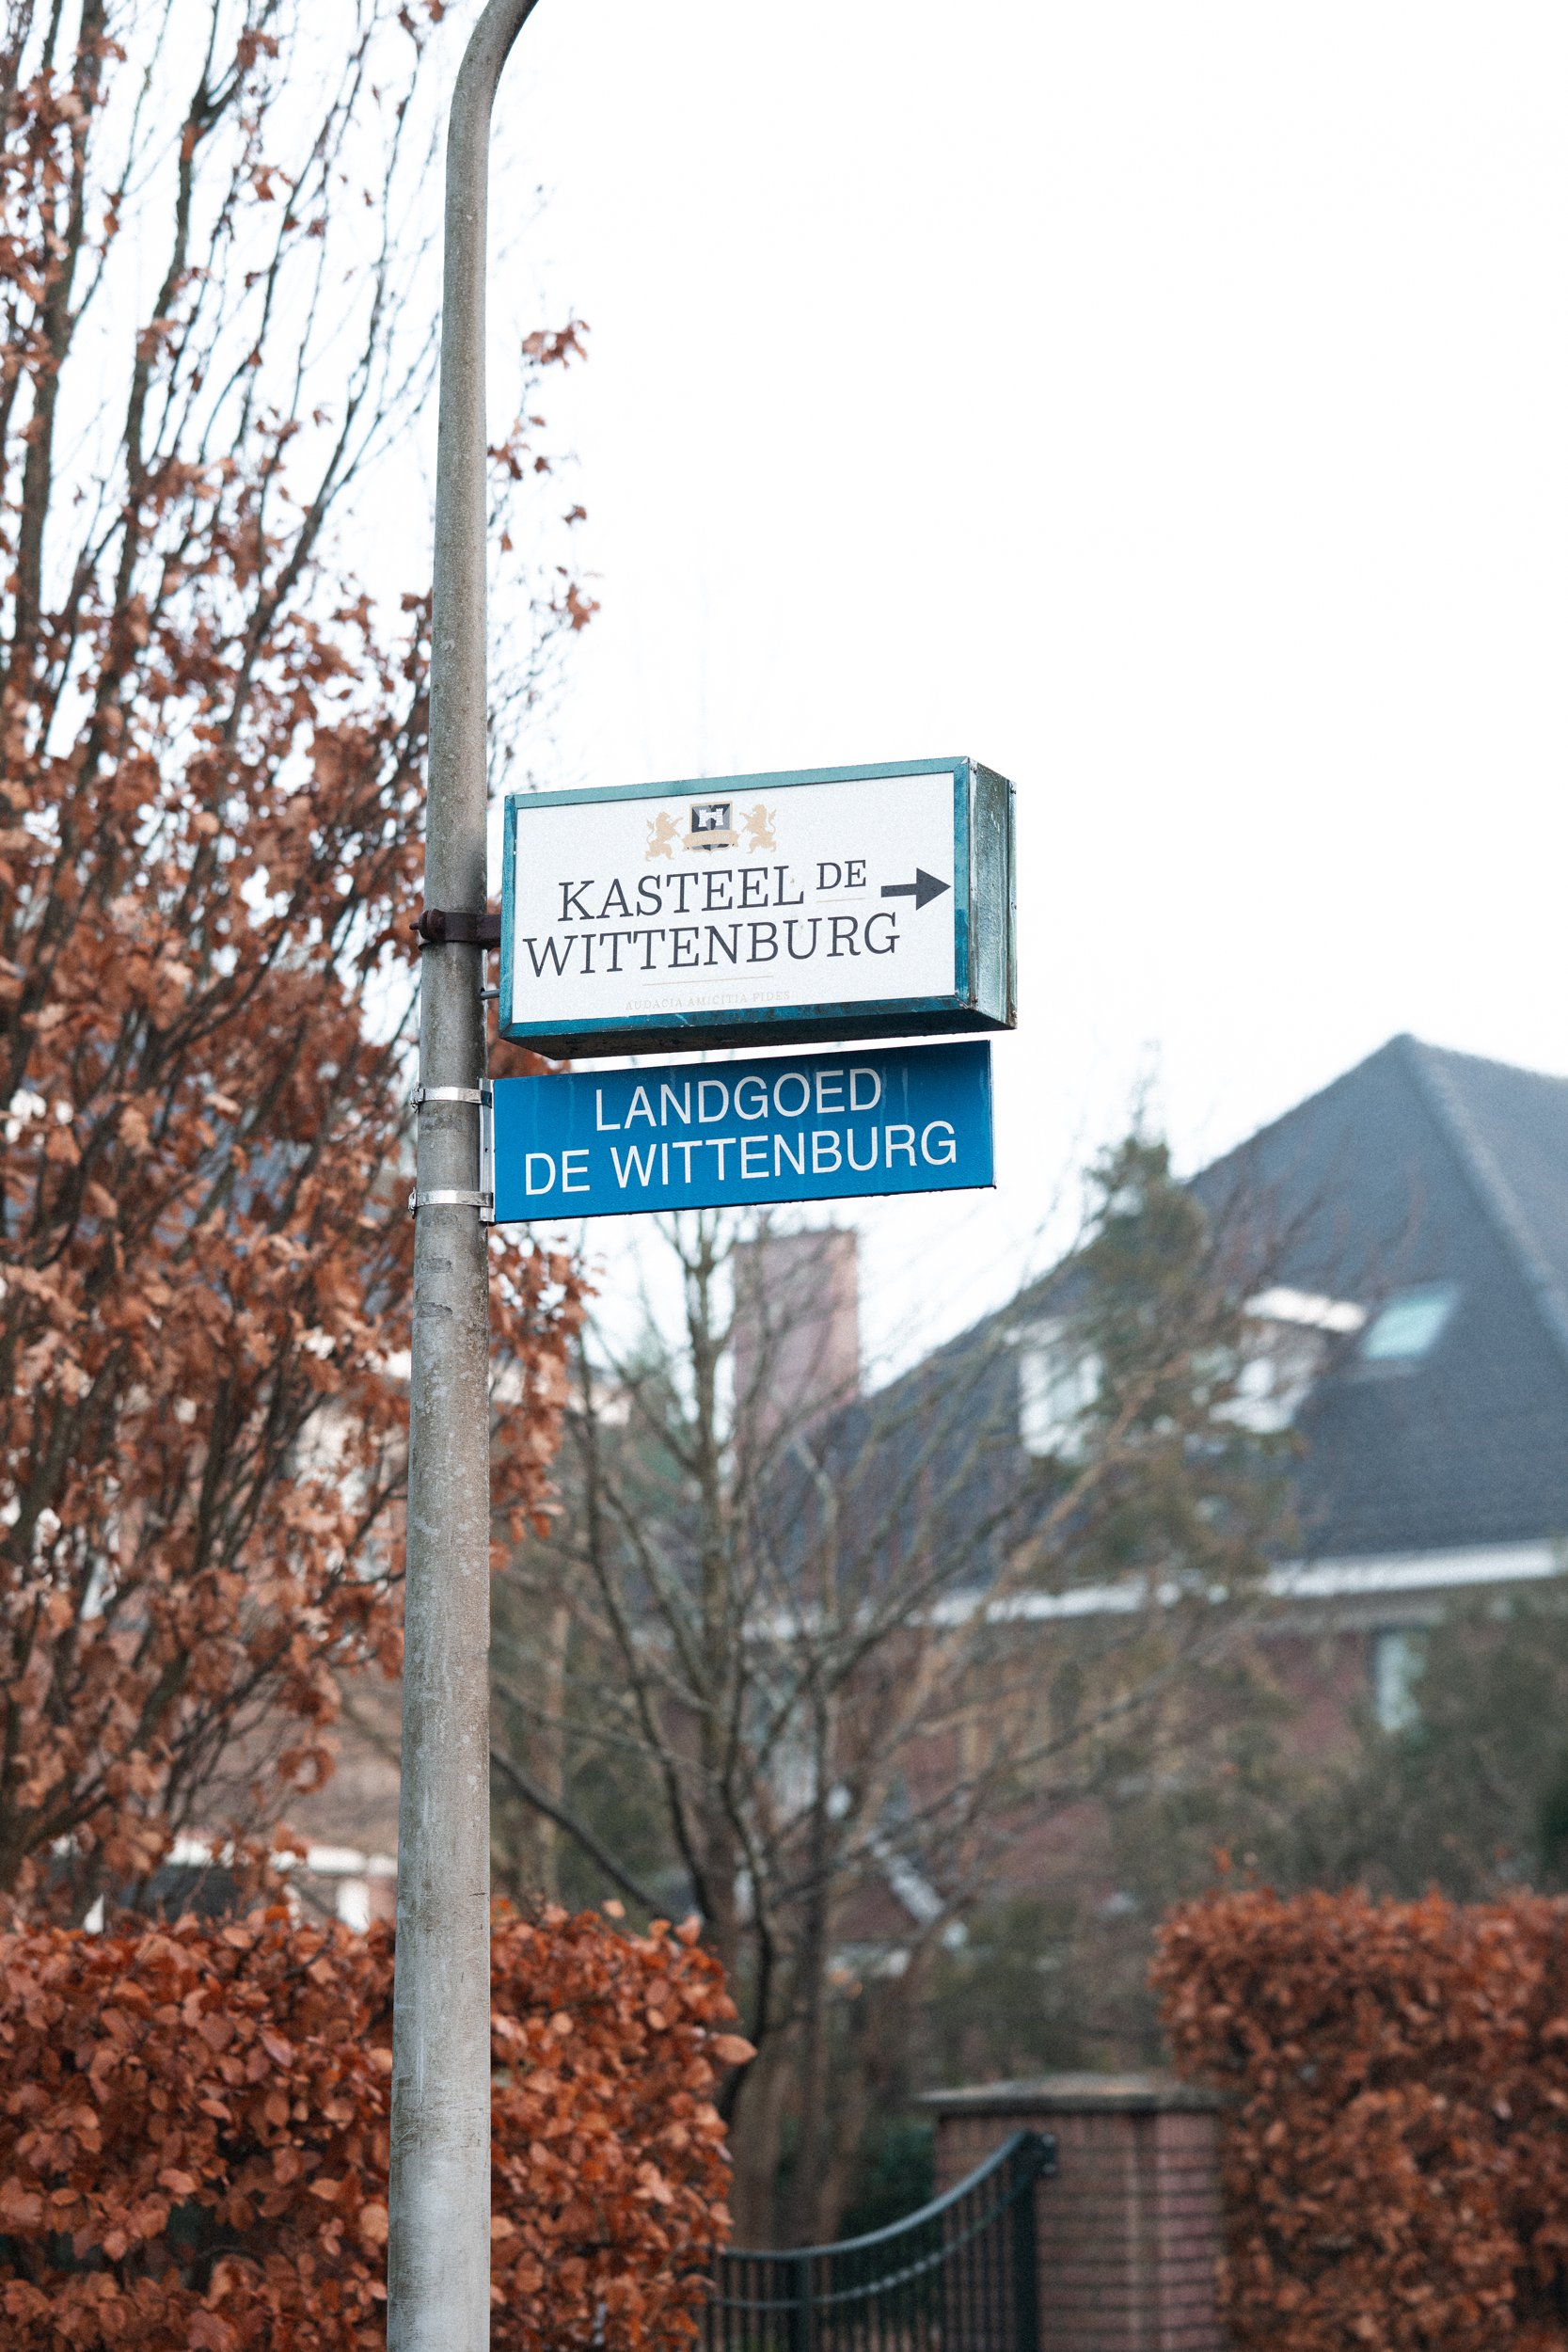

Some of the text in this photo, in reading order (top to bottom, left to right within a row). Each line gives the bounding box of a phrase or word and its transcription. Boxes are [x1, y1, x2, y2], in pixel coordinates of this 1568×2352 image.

[558, 859, 867, 922] KASTEEL DE
[523, 912, 900, 977] WITTENBURG
[626, 991, 791, 1010] AUDACIA AMICITIA FIDES
[595, 1068, 882, 1132] LANDGOED
[525, 1120, 957, 1196] DE WITTENBURG
